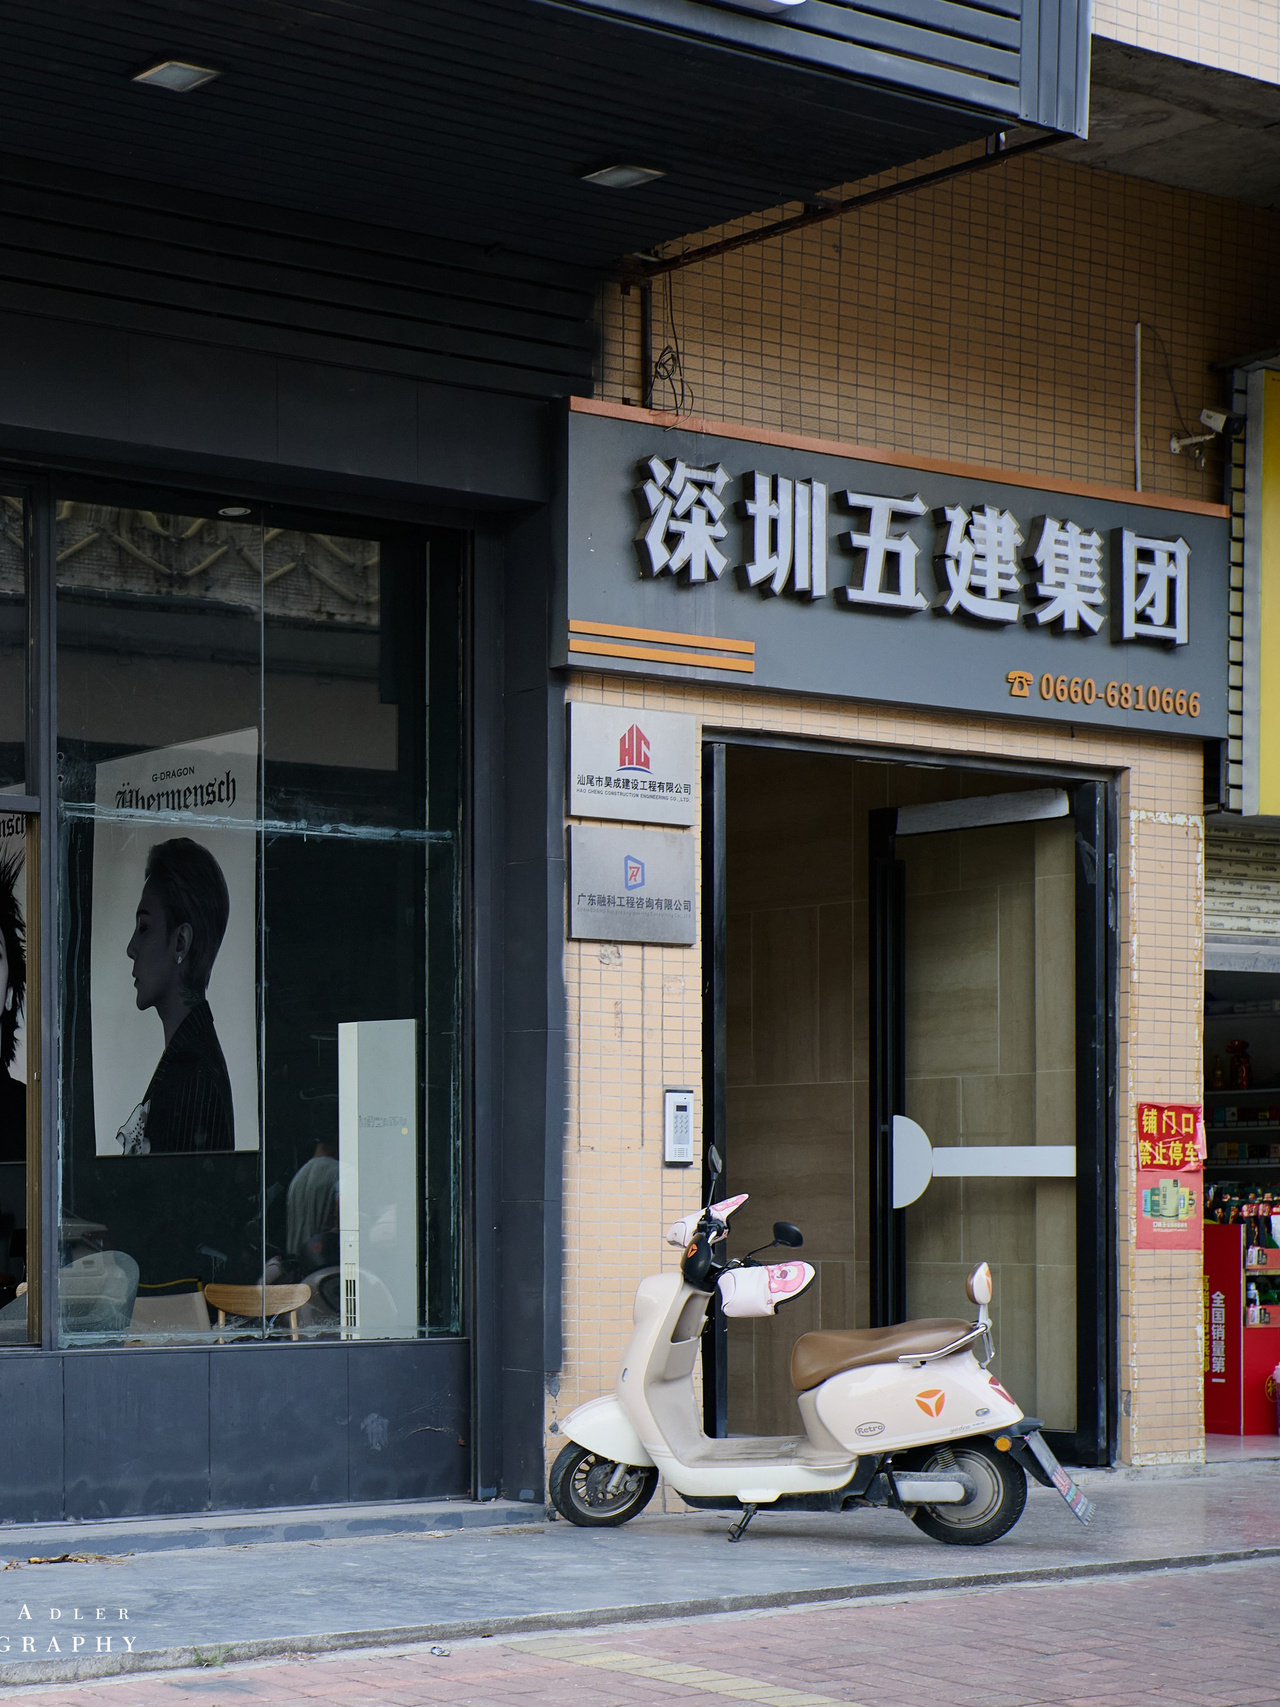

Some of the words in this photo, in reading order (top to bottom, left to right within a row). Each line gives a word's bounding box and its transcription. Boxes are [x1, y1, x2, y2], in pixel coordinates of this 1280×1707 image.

[634, 454, 1192, 647] 深圳五建集团
[1040, 672, 1202, 718] 0660-6810666
[151, 766, 195, 782] G-DRAGON
[576, 892, 692, 913] 广东融科工程咨询有限公司
[1142, 1108, 1194, 1135] 铺门口
[1138, 1139, 1201, 1167] 禁止停车
[1211, 1290, 1226, 1384] 全国销量第一
[857, 1424, 882, 1434] Retro
